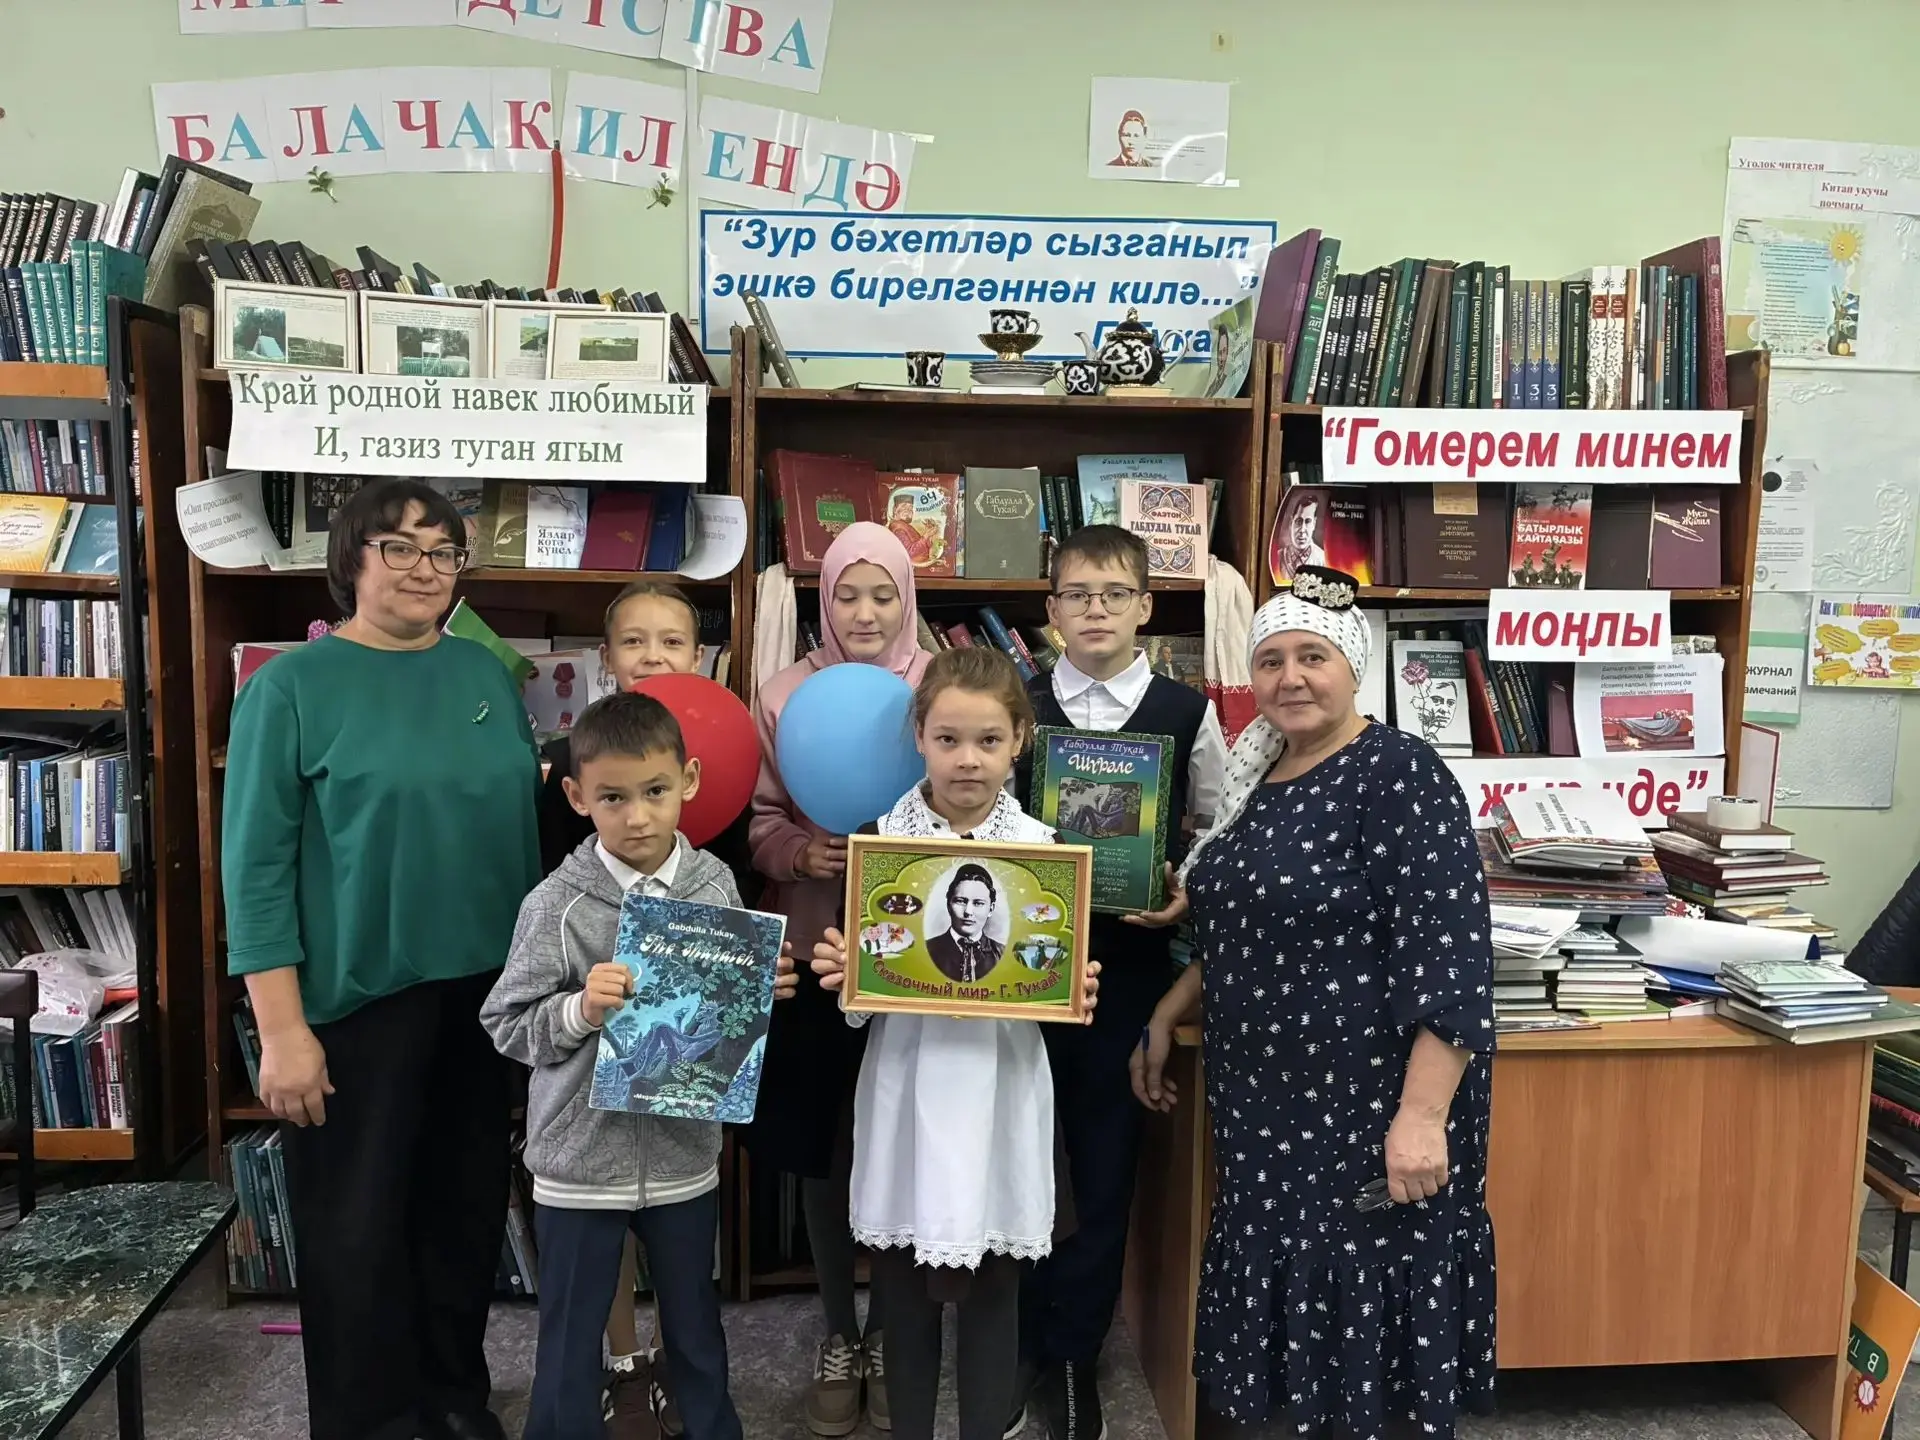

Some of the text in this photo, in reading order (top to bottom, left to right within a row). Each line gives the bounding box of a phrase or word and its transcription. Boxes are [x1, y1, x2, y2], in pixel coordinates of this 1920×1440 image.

[1738, 156, 1825, 172] Уголок читателя
[1821, 181, 1889, 201] Китап укучы
[1819, 198, 1865, 212] почмагы
[723, 218, 1250, 262] “Зур бәхетләр сызганып
[713, 273, 817, 300] эшкә
[830, 269, 1096, 308] бирелгәннән
[1330, 296, 1339, 318] КНИГА
[1345, 295, 1353, 317] КНИГА
[1360, 294, 1369, 317] КНИГА
[1472, 300, 1481, 342] ШАКИРОВ
[1453, 343, 1462, 371] КРАСОТА
[238, 372, 695, 416] Край родной навек любимый
[1514, 384, 1520, 396] 1
[1529, 384, 1540, 396] 3
[1547, 384, 1557, 396] 3
[313, 427, 624, 467] И, газиз туган ягым
[1324, 416, 1732, 478] “Гомерем минем
[985, 493, 1024, 508] Габдулла
[993, 503, 1019, 517] Тукай
[1151, 510, 1182, 519] ФАЭТОН
[1686, 508, 1708, 519] Муса
[187, 521, 209, 539] район
[223, 511, 243, 524] своим
[1130, 521, 1202, 536] ГАБДУЛЛА ТУКАЙ
[1517, 523, 1584, 535] БАТЫРЛЫК
[537, 528, 575, 542] Язлар
[1153, 538, 1180, 546] ВЕСНЫ
[1516, 534, 1584, 545] КАЙТАВАЗЫ
[1495, 610, 1663, 656] моңлы
[1744, 666, 1793, 677] ЖУРНАЛ
[1483, 679, 1500, 713] ТУФАН
[1744, 685, 1797, 697] амечаний
[1063, 738, 1145, 755] Габдулла Тукай
[1067, 754, 1136, 776] Шүрәле
[668, 922, 736, 940] Gabdulla Tukay
[640, 933, 676, 954] The
[872, 958, 953, 998] Сказочный
